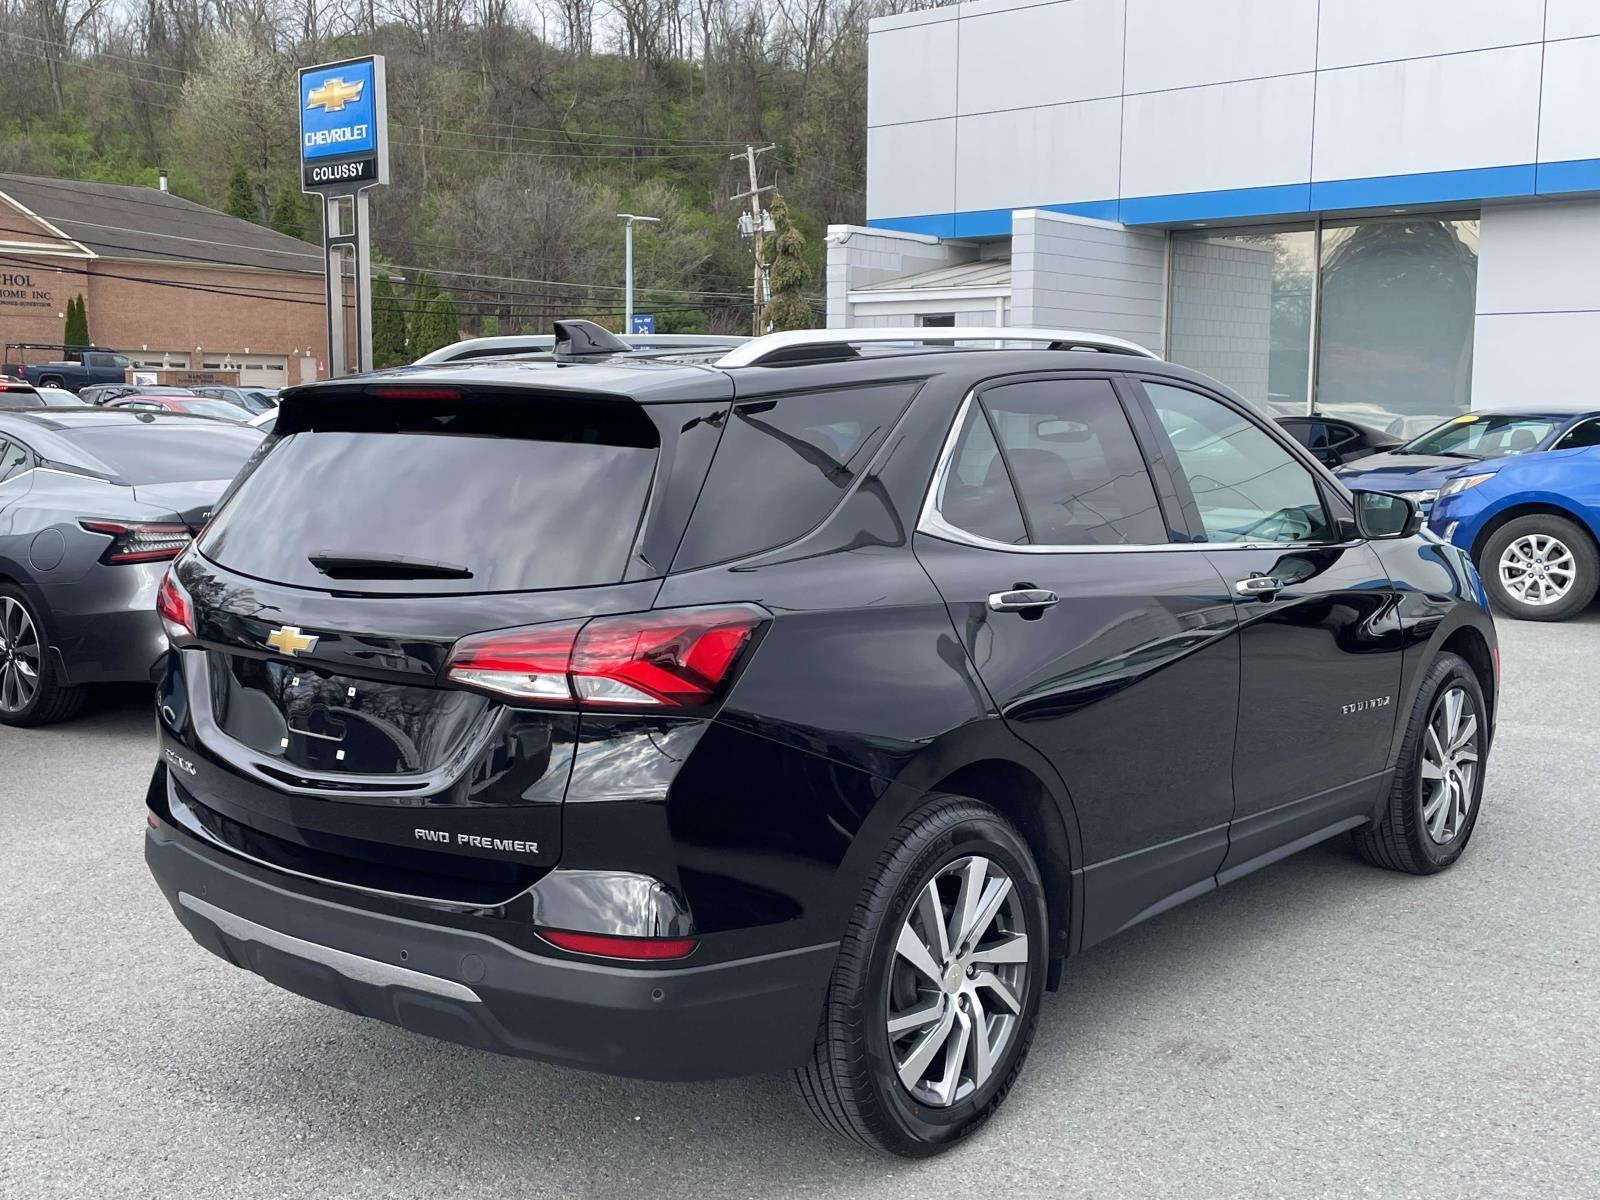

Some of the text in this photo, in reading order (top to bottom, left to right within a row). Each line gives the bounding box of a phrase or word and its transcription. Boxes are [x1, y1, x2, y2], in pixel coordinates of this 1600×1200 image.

[305, 124, 368, 146] CHEVROLET
[313, 162, 364, 181] COLUSSY
[0, 273, 35, 287] HOL
[1341, 696, 1390, 715] EQUINOX
[414, 828, 539, 854] AWD PREMIER
